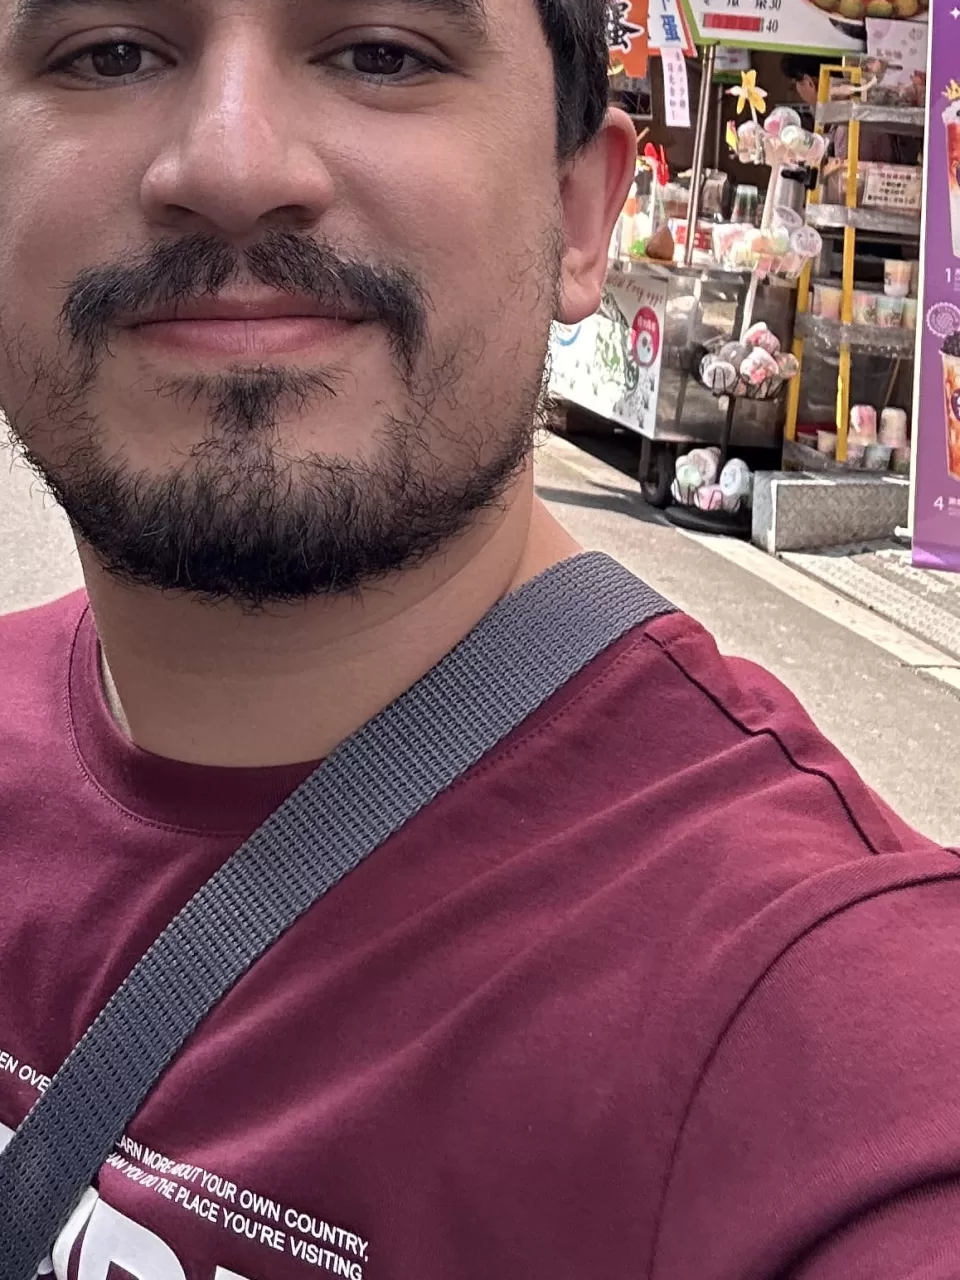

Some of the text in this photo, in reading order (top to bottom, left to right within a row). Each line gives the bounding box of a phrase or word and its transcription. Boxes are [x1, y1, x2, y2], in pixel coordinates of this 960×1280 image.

[766, 19, 779, 34] 40
[945, 267, 951, 283] 1
[933, 495, 944, 511] 4
[18, 1064, 52, 1094] OVE
[116, 1134, 142, 1161] ARN
[141, 1147, 175, 1174] MORE
[200, 1169, 238, 1204] YOUR
[240, 1189, 281, 1223] OWN
[284, 1208, 369, 1263] COUNTRY,
[122, 1163, 145, 1181] YOU
[139, 1173, 160, 1188] DO
[153, 1177, 179, 1200] THE
[174, 1185, 221, 1223] PLACE
[222, 1207, 287, 1252] YOU'RE
